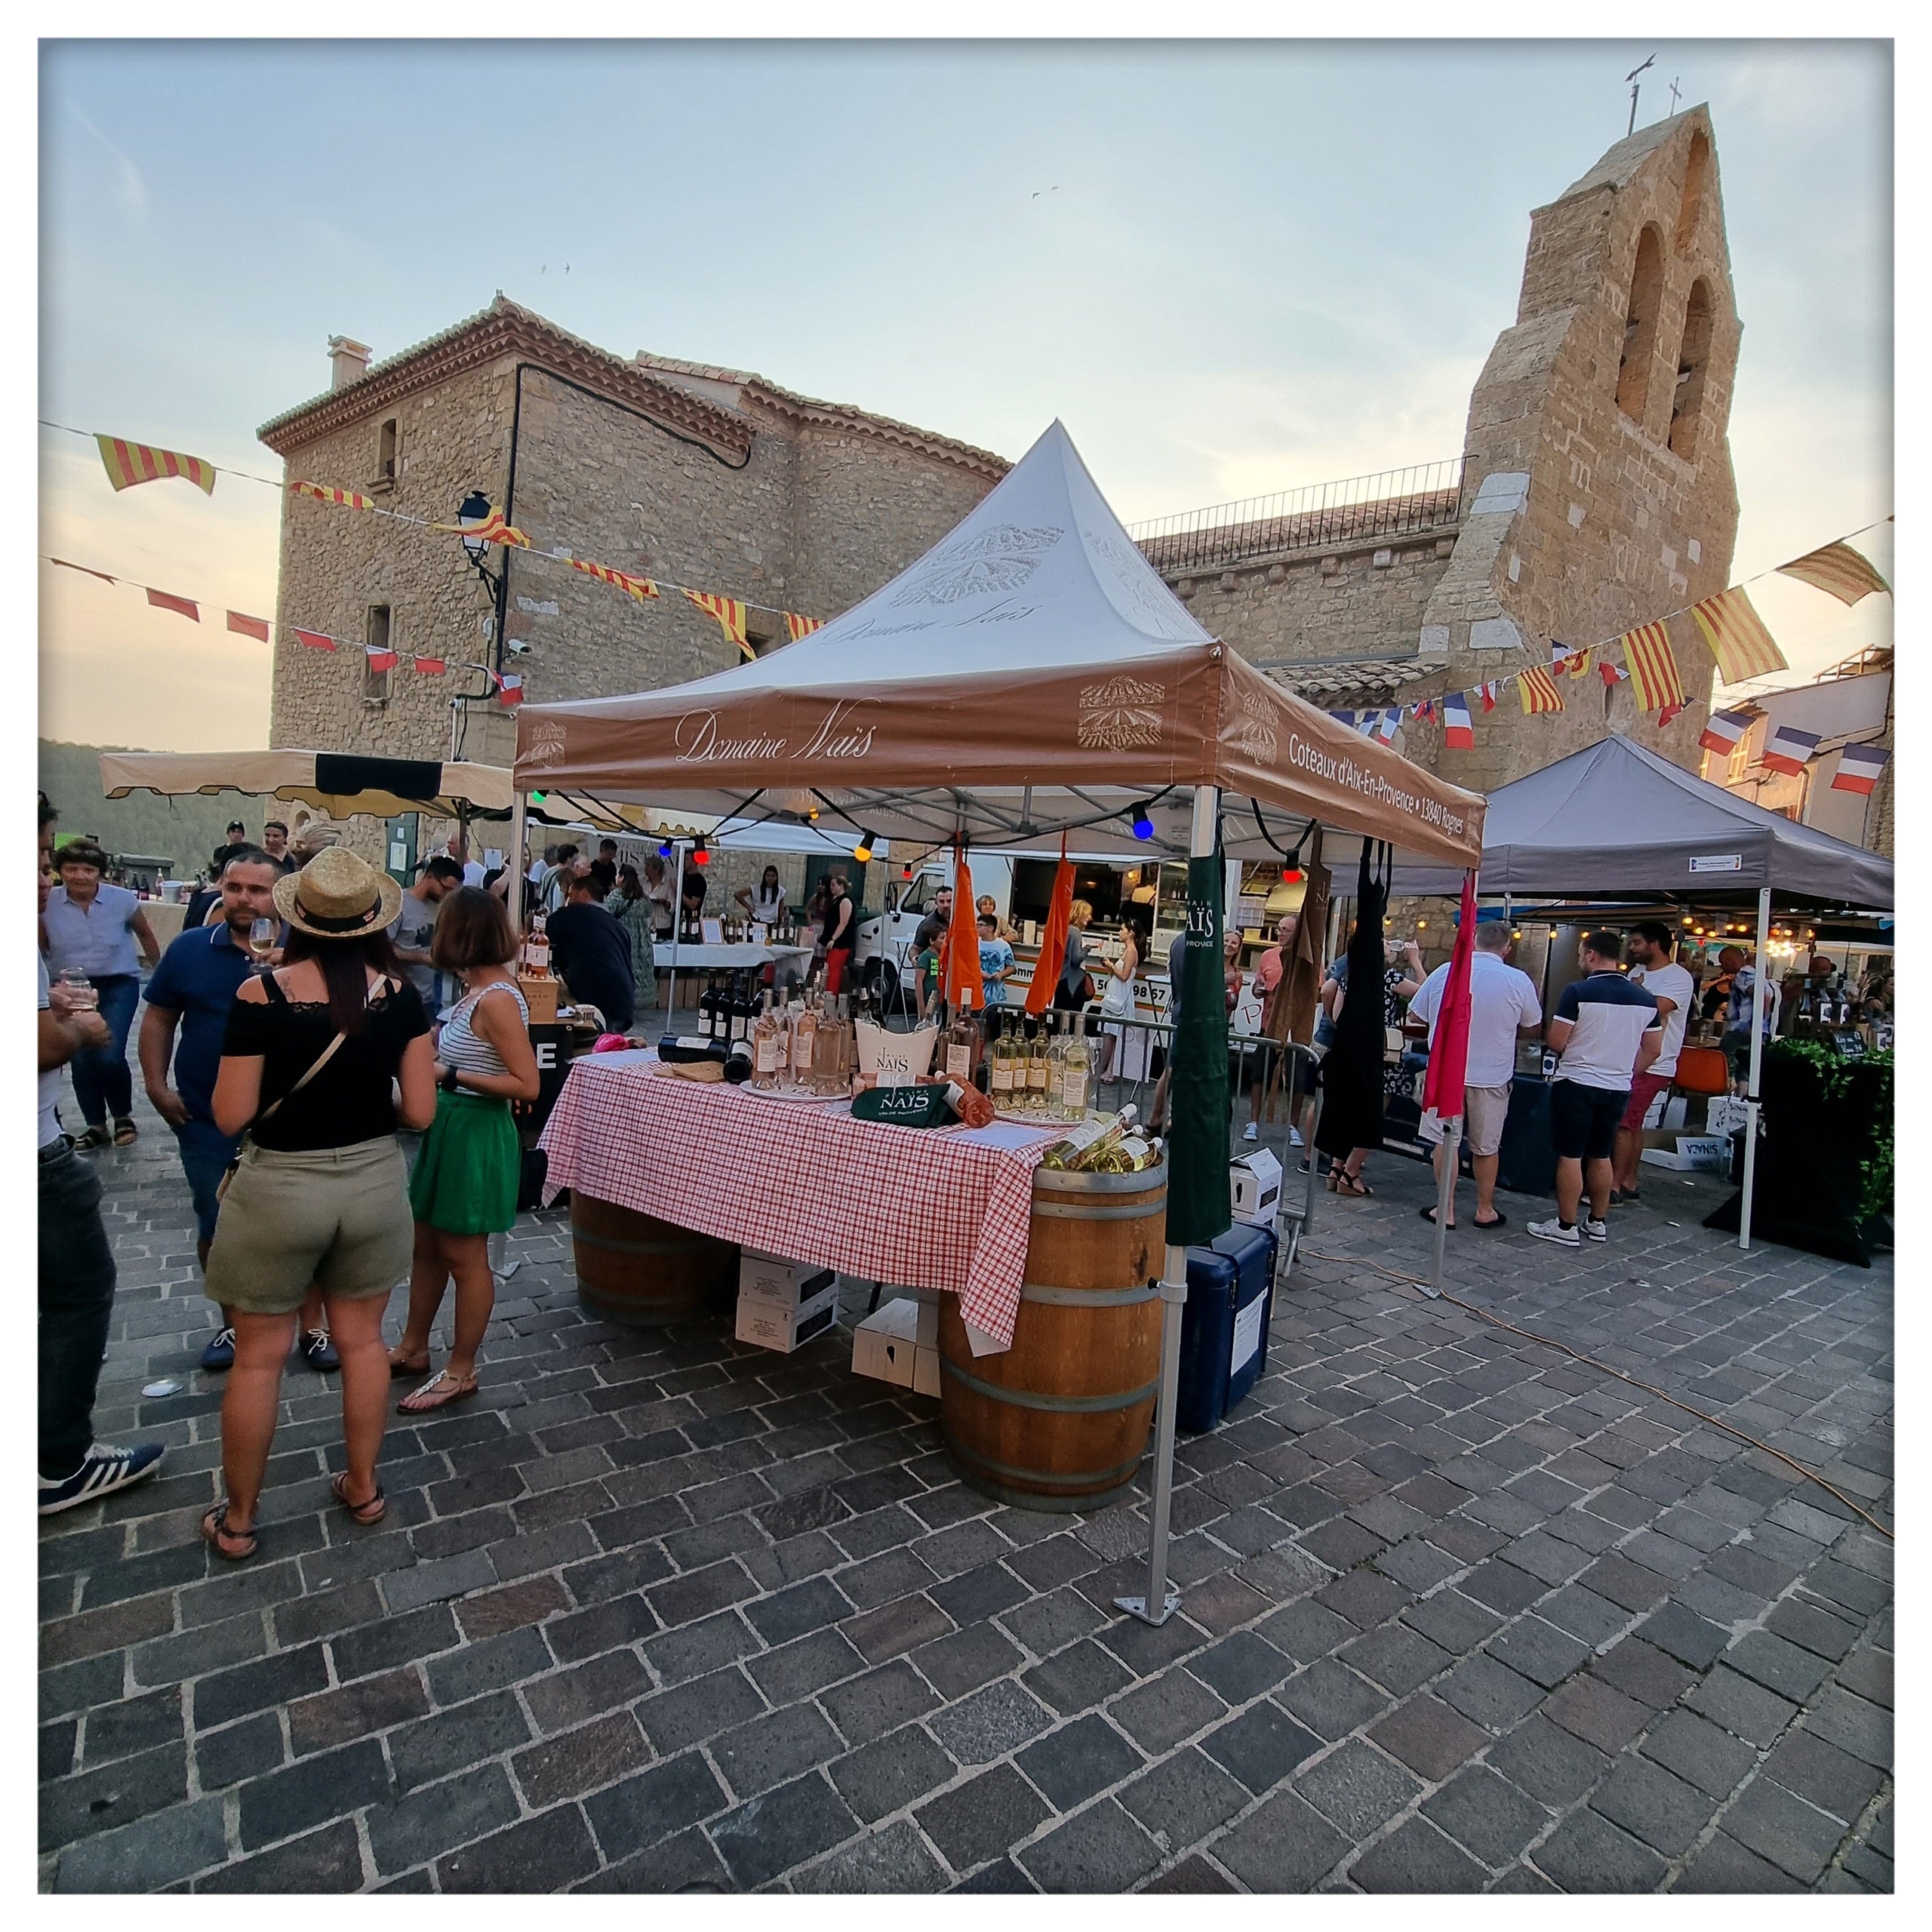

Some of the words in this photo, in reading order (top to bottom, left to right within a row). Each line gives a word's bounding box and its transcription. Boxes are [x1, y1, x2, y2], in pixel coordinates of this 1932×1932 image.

[675, 708, 788, 763] Domaine
[790, 697, 881, 759] Naïs
[1289, 733, 1336, 781] Coteaux
[1338, 755, 1414, 814] d'Aix-En-Provence
[1420, 797, 1442, 826] 13840
[1442, 807, 1464, 836] Rognes
[1184, 907, 1214, 938] AÏS
[1011, 969, 1035, 979] omm
[1132, 985, 1148, 998] 98
[1151, 988, 1166, 1001] 67
[537, 1043, 557, 1069] E
[876, 1054, 909, 1072] NAÏS
[880, 1090, 930, 1109] NAÏS
